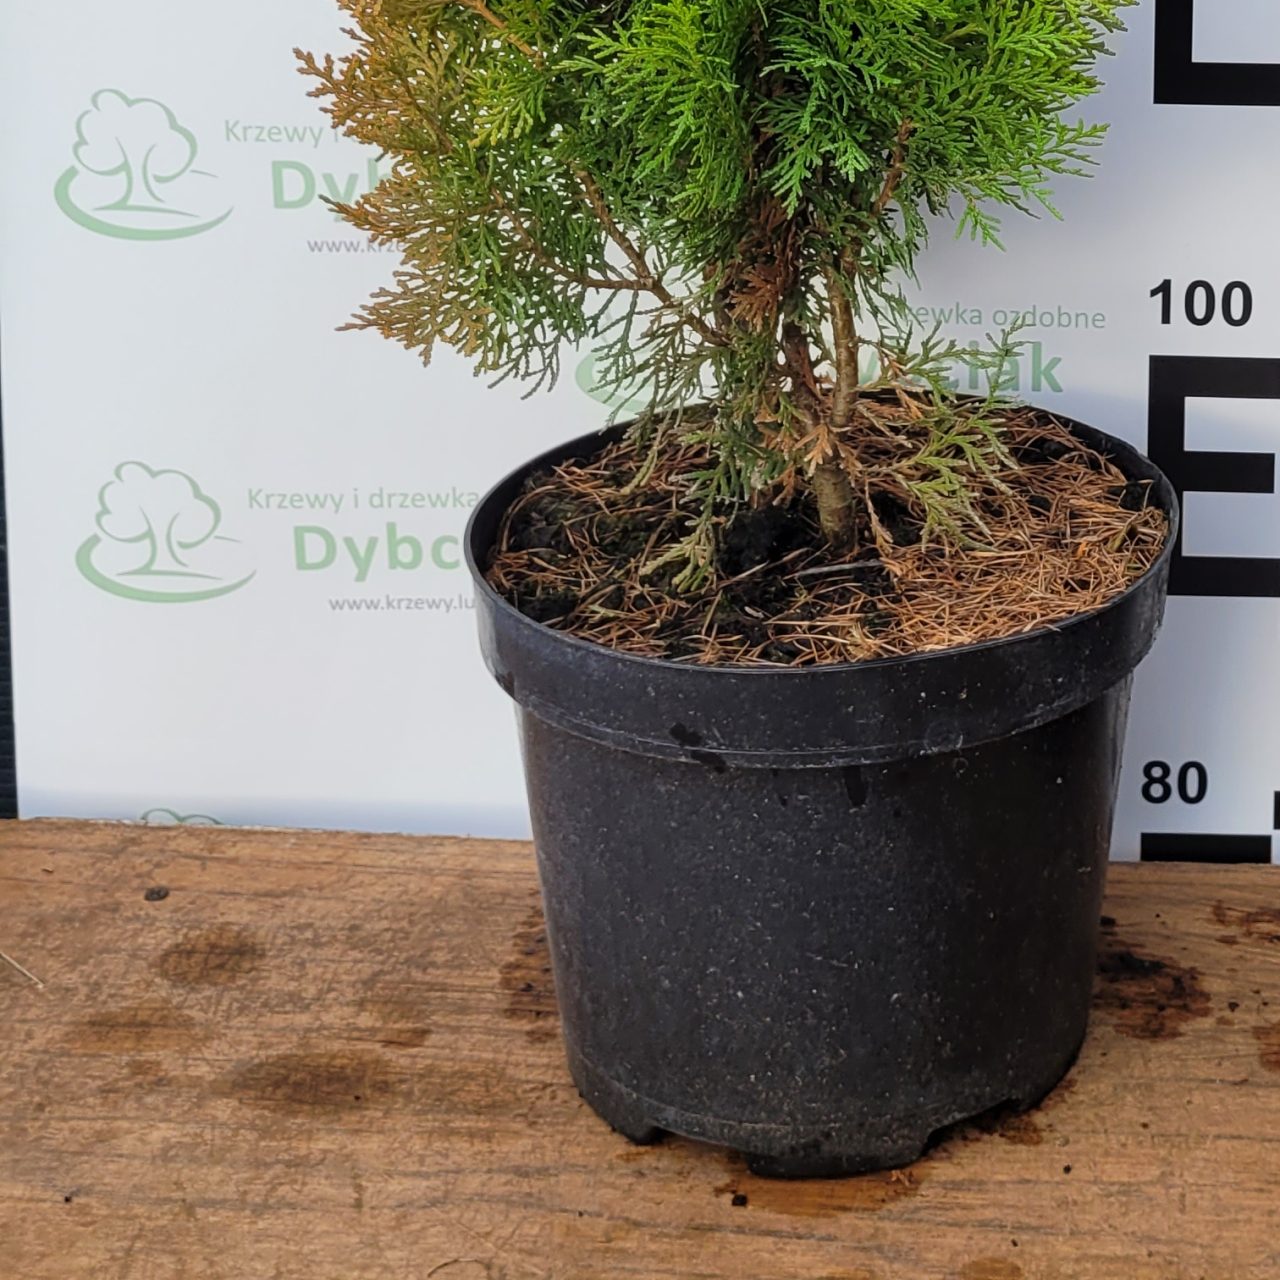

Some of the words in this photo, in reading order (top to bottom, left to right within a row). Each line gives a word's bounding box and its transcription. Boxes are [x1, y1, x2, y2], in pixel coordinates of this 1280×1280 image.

[224, 119, 324, 149] Krzewy
[1149, 278, 1253, 328] 100
[247, 487, 345, 515] Krzewy
[352, 487, 359, 509] i
[293, 521, 461, 583] Dybc
[1140, 760, 1208, 805] 80
